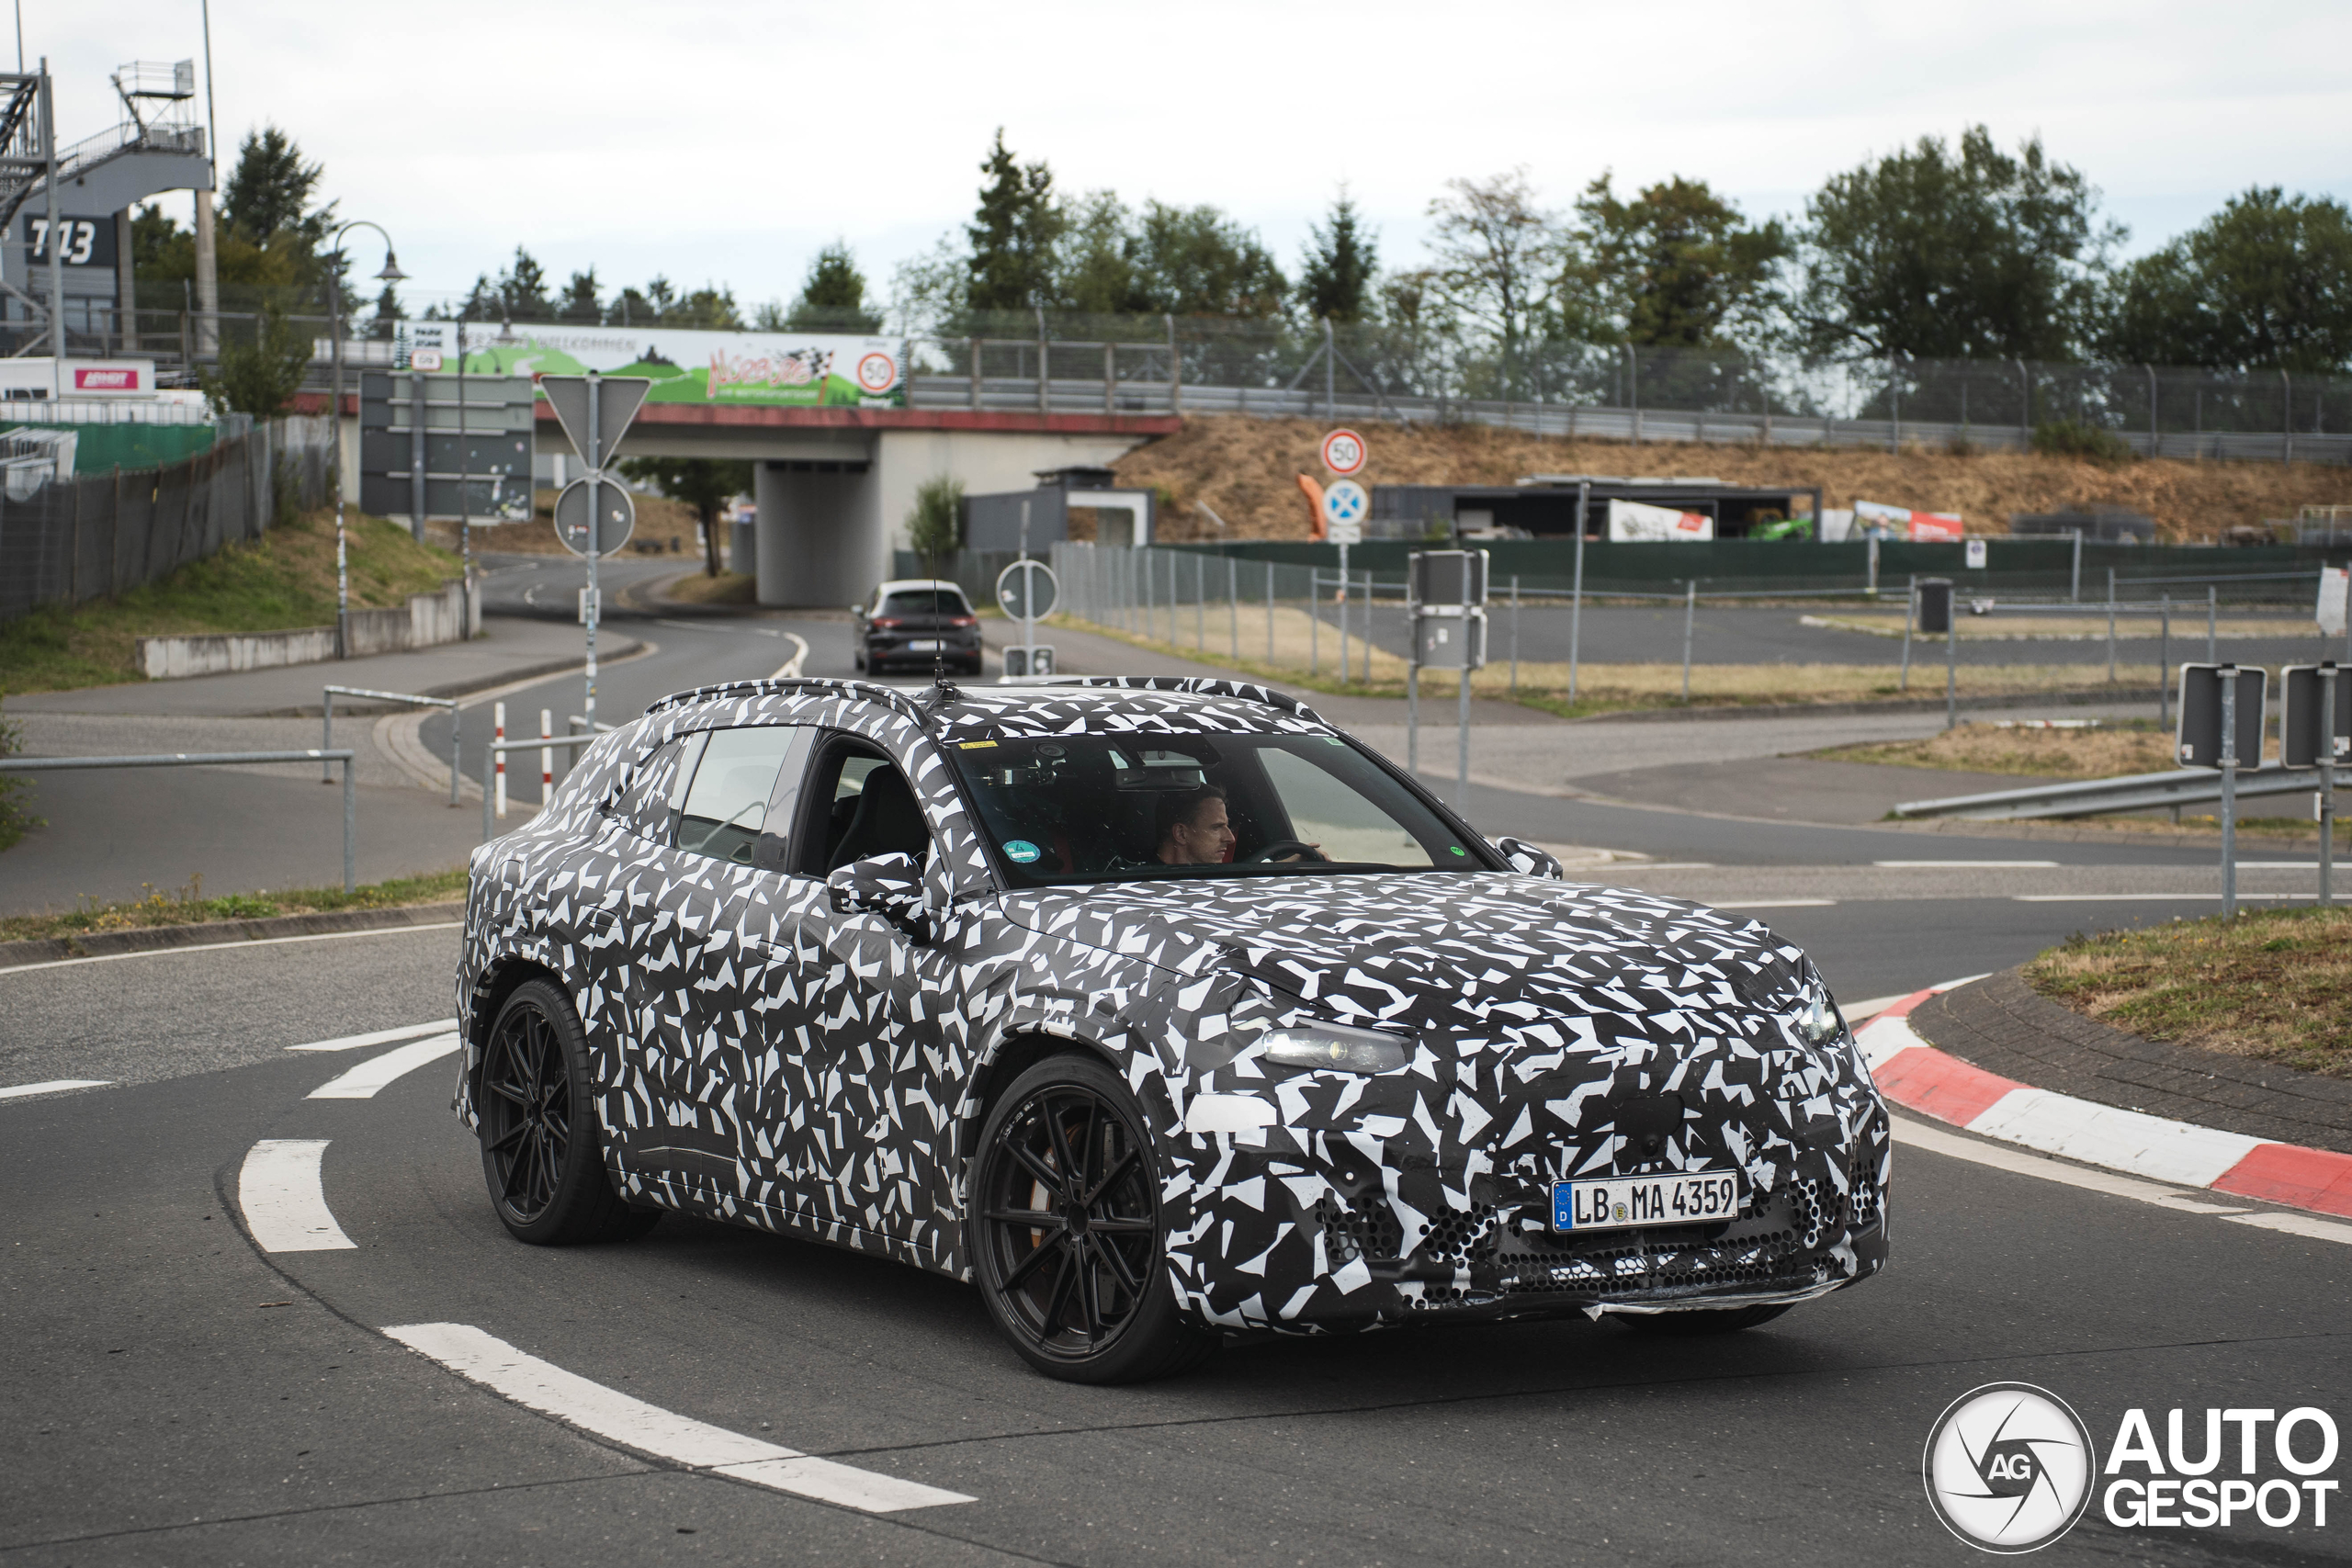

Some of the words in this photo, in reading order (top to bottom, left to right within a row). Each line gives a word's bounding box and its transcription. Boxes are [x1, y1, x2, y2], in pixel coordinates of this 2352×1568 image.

[31, 220, 96, 264] T13
[865, 362, 888, 381] 50
[1333, 443, 1357, 461] 50
[1575, 1188, 1609, 1224] LB
[1632, 1184, 1665, 1220] MA
[1671, 1179, 1734, 1216] 4359
[1559, 1211, 1567, 1223] D
